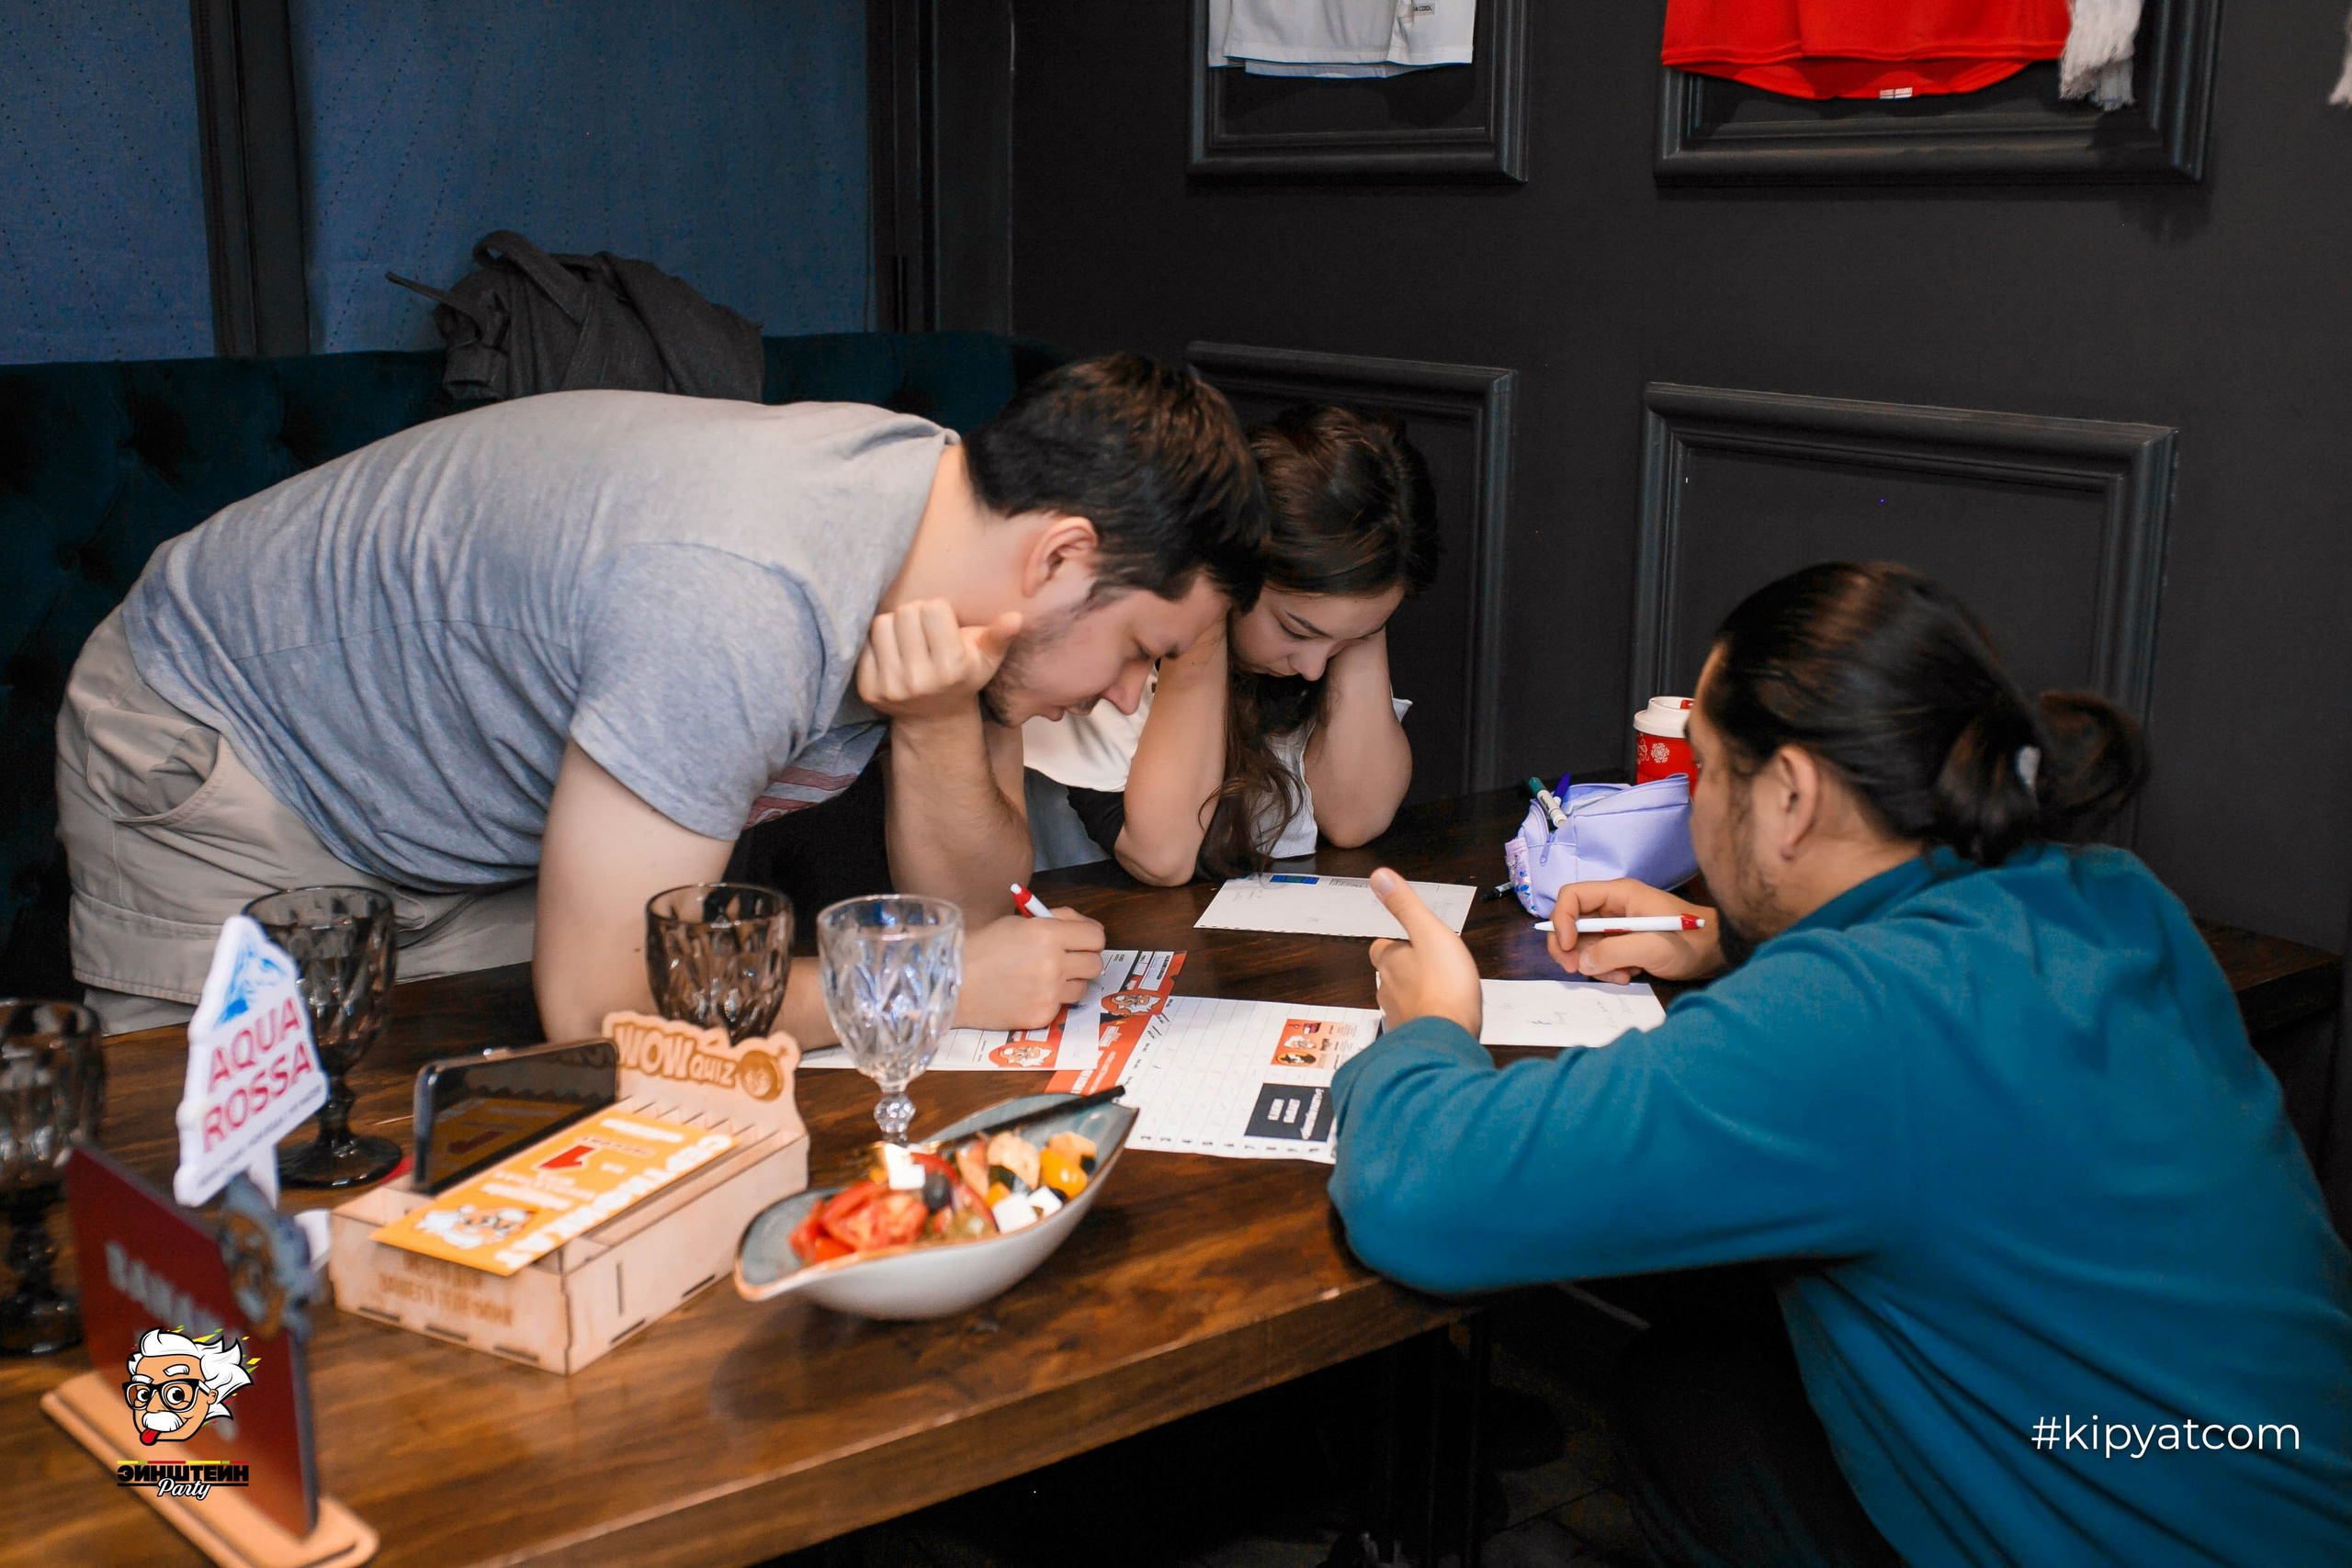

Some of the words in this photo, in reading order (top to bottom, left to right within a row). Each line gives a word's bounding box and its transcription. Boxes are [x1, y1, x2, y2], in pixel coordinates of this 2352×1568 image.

[208, 997, 300, 1093] AQUA
[614, 1022, 696, 1080] WOW
[203, 1041, 312, 1154] ROSSA
